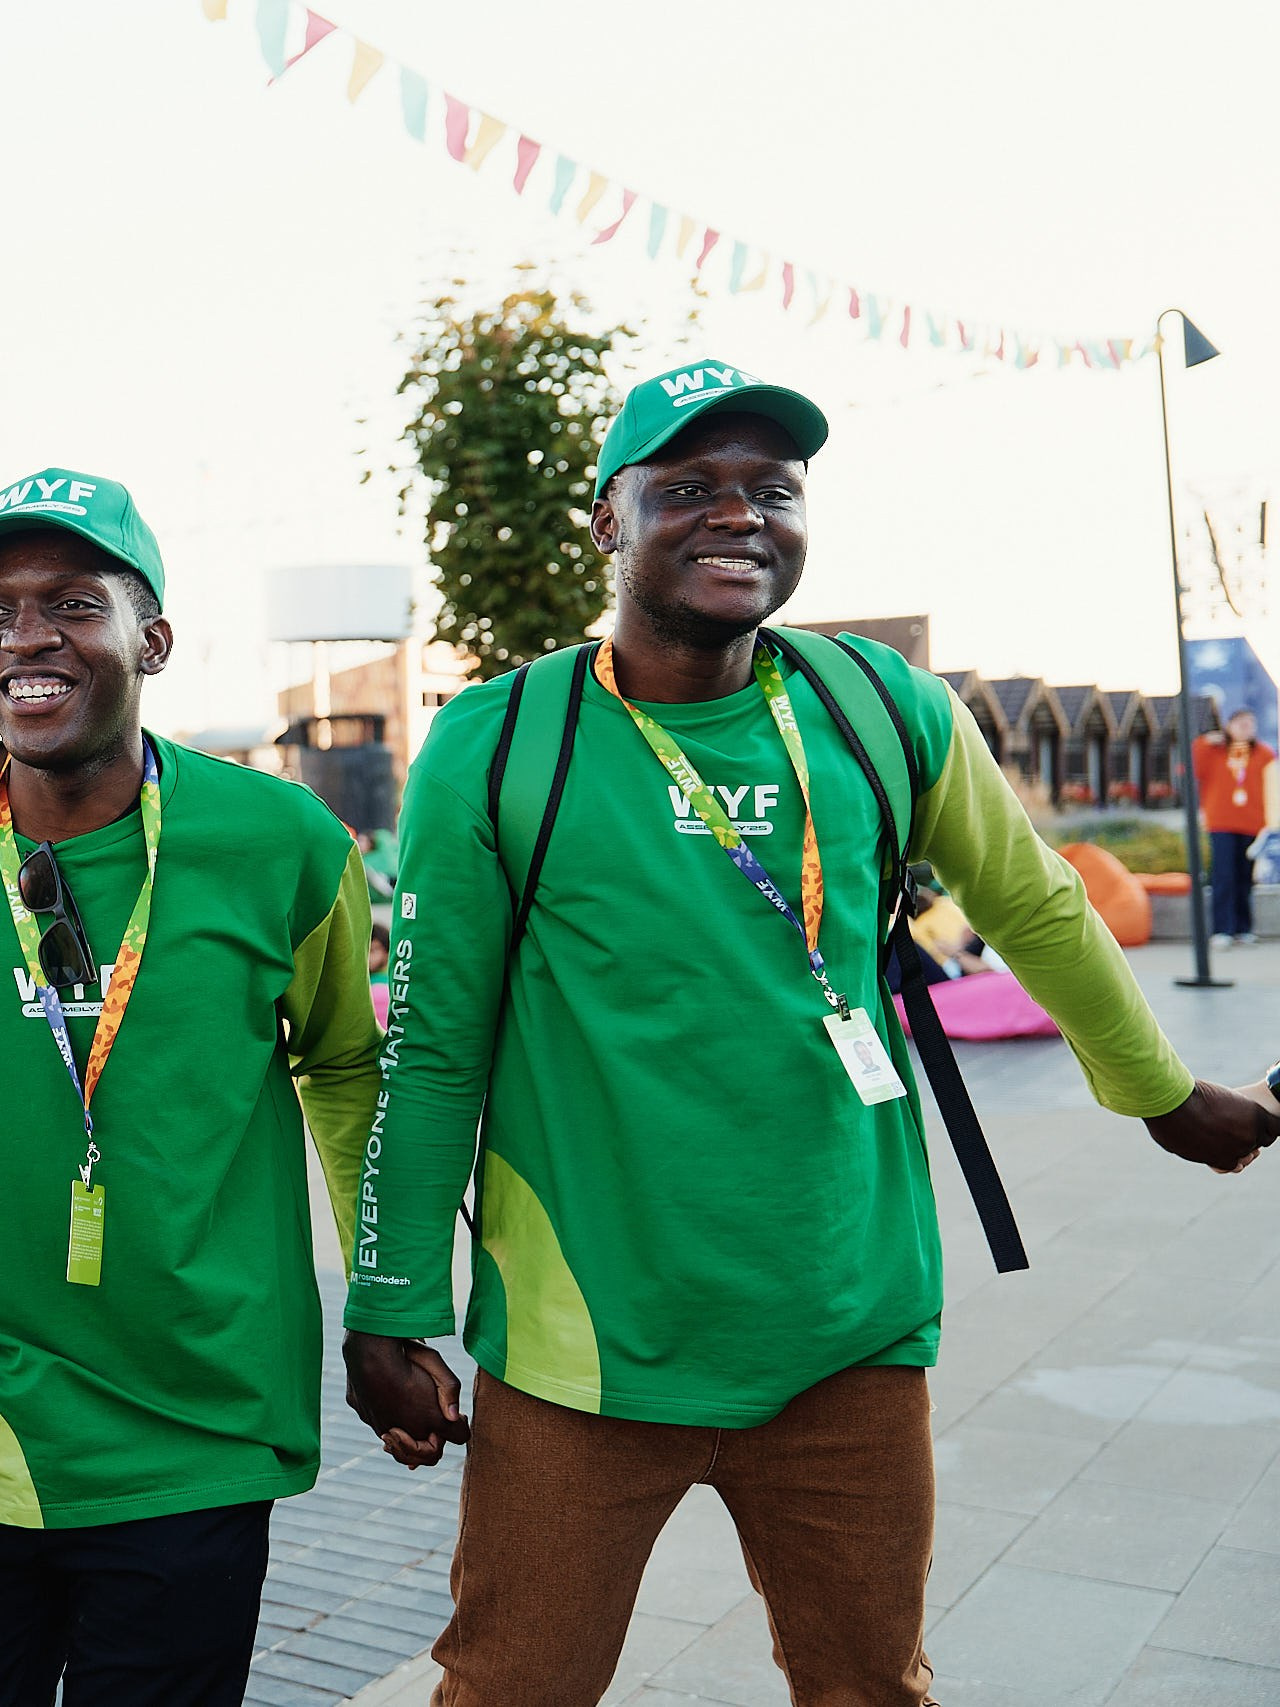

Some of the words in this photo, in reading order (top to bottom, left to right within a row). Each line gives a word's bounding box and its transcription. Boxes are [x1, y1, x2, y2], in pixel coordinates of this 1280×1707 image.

[775, 694, 798, 731] WYF
[666, 760, 697, 796] WYF
[667, 784, 780, 819] WYF
[755, 881, 787, 912] WYF
[51, 1027, 71, 1068] WYF
[358, 1090, 391, 1269] EVERYONE
[380, 938, 413, 1080] MATTERS
